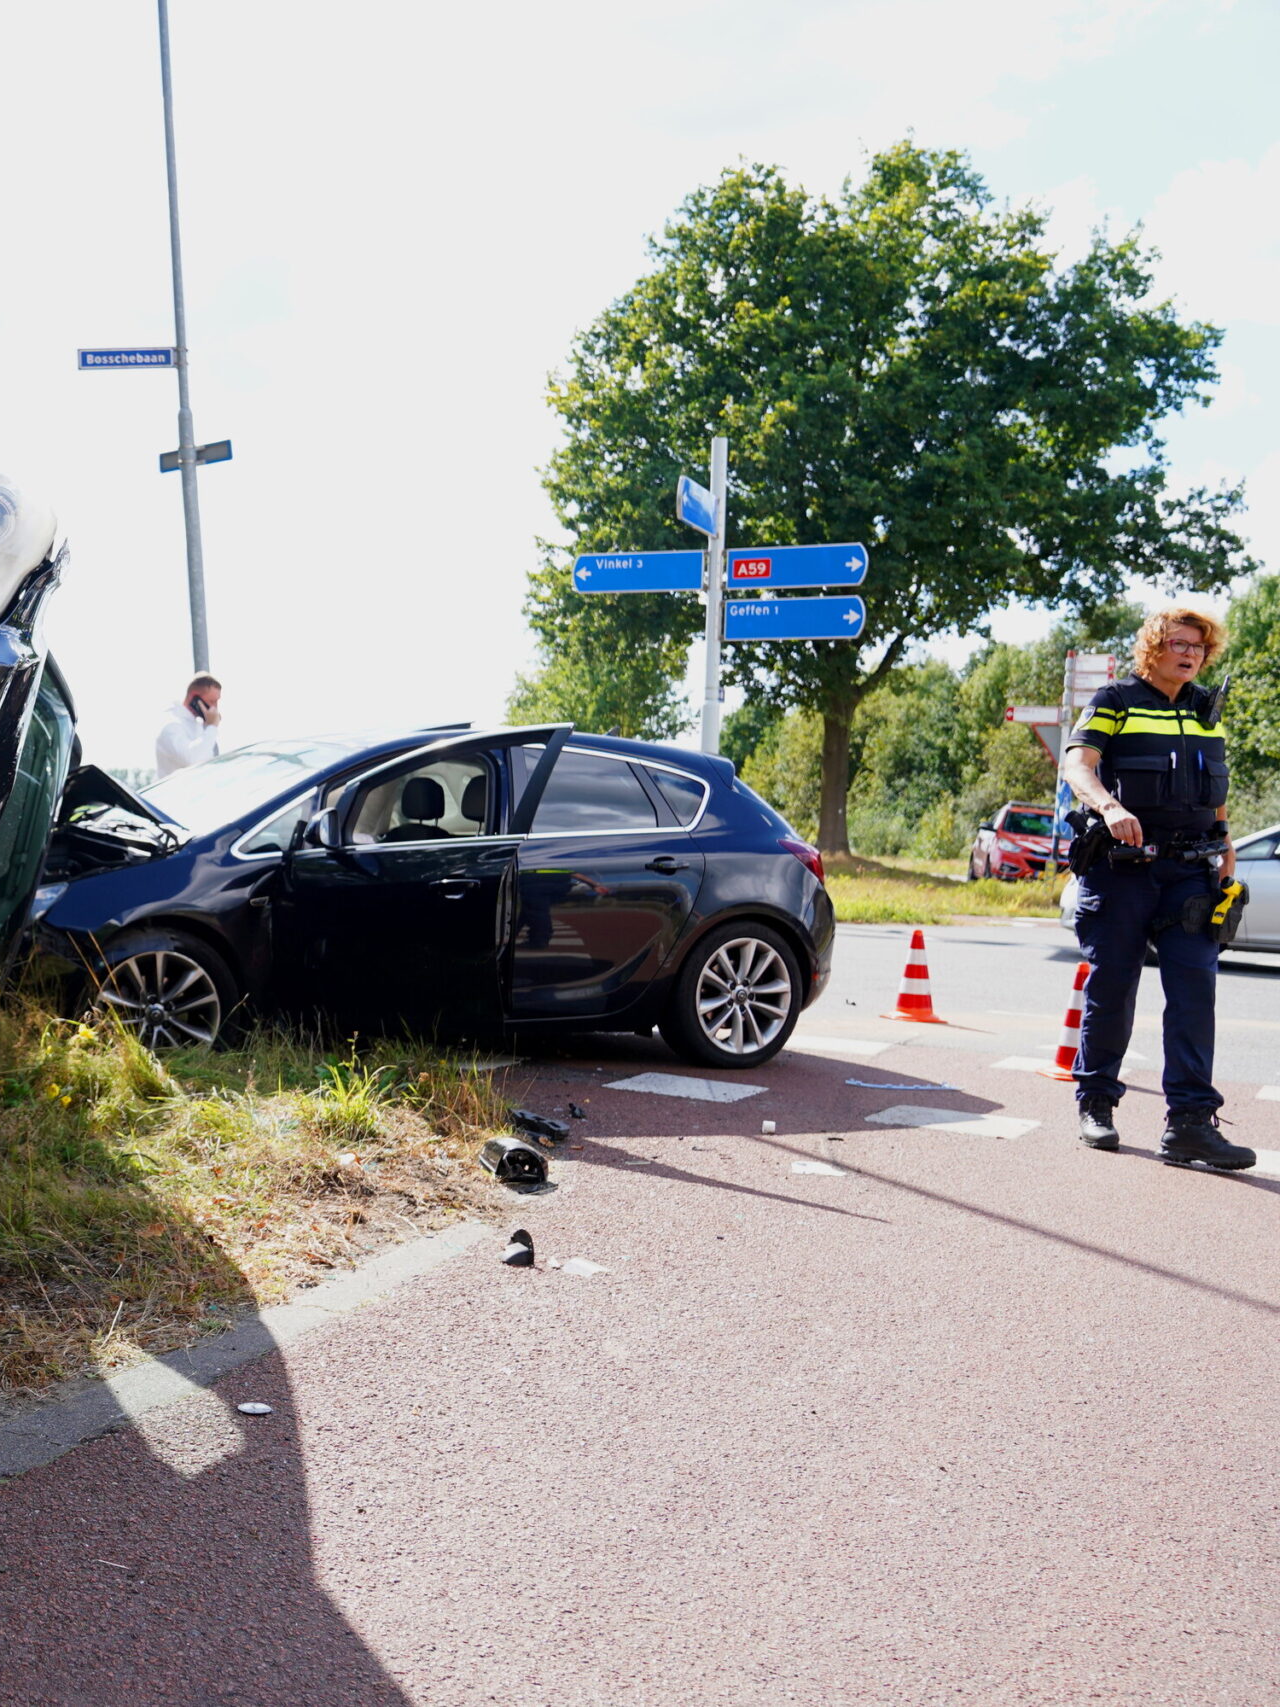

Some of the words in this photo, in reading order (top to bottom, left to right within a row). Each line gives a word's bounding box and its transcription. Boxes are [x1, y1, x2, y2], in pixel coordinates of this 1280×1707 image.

[86, 352, 166, 365] Bosschebaan
[595, 558, 633, 569] Vinkel
[636, 559, 644, 569] 3
[737, 562, 767, 576] A59
[729, 604, 770, 616] Geffen
[774, 605, 779, 616] 1
